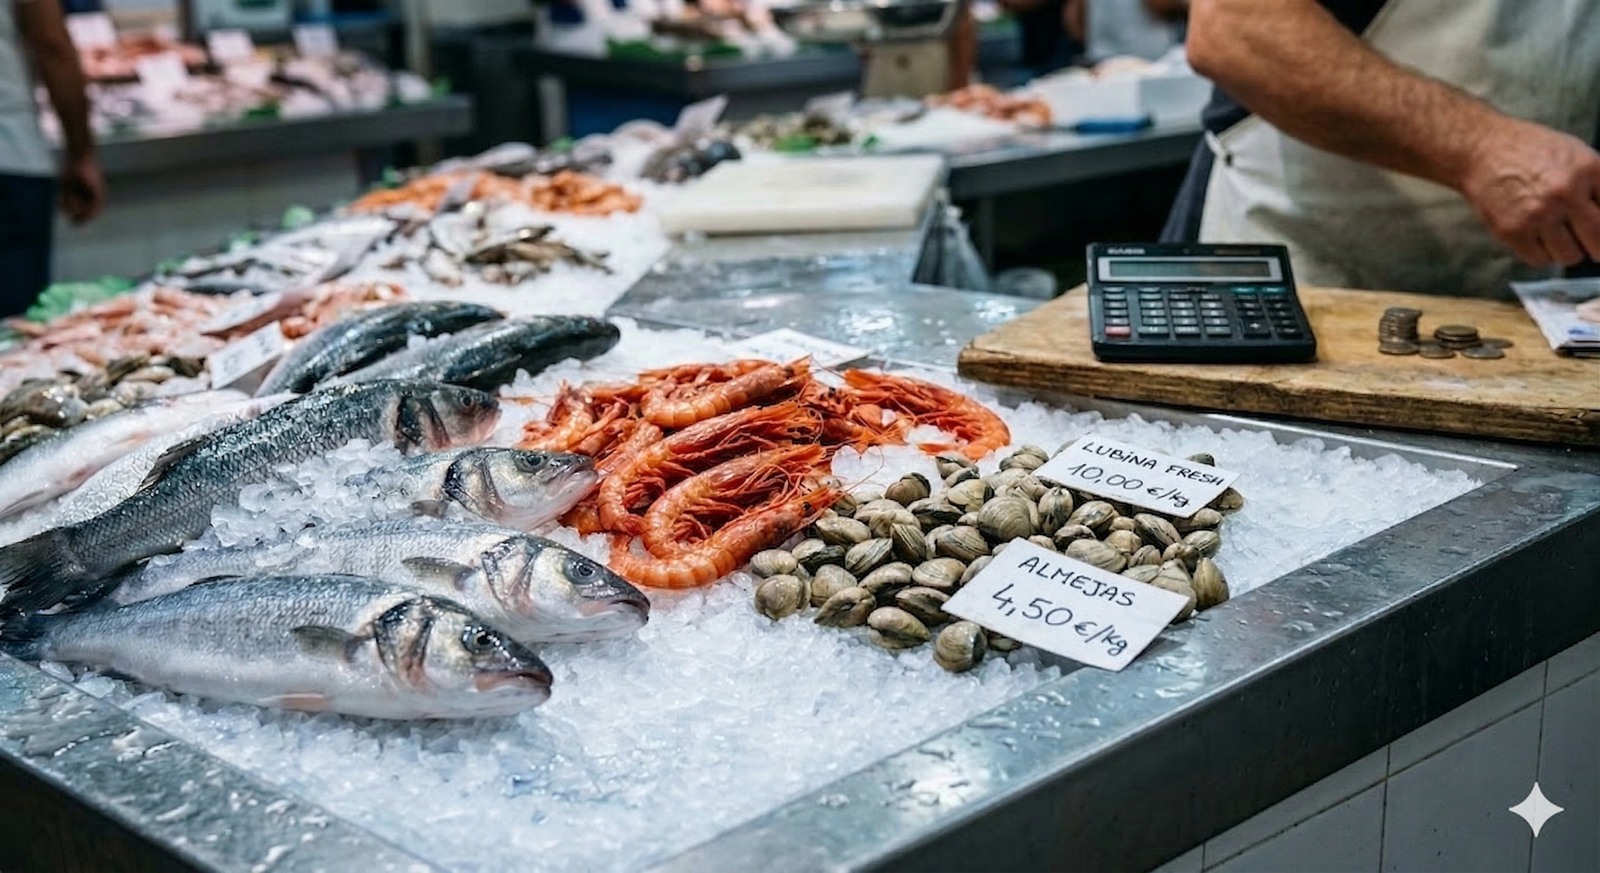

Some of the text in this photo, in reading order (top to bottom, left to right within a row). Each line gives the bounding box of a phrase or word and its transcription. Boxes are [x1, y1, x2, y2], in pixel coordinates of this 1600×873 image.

[1082, 441, 1225, 487] LUBINA FRESH
[1018, 555, 1136, 607] ALMEJAS
